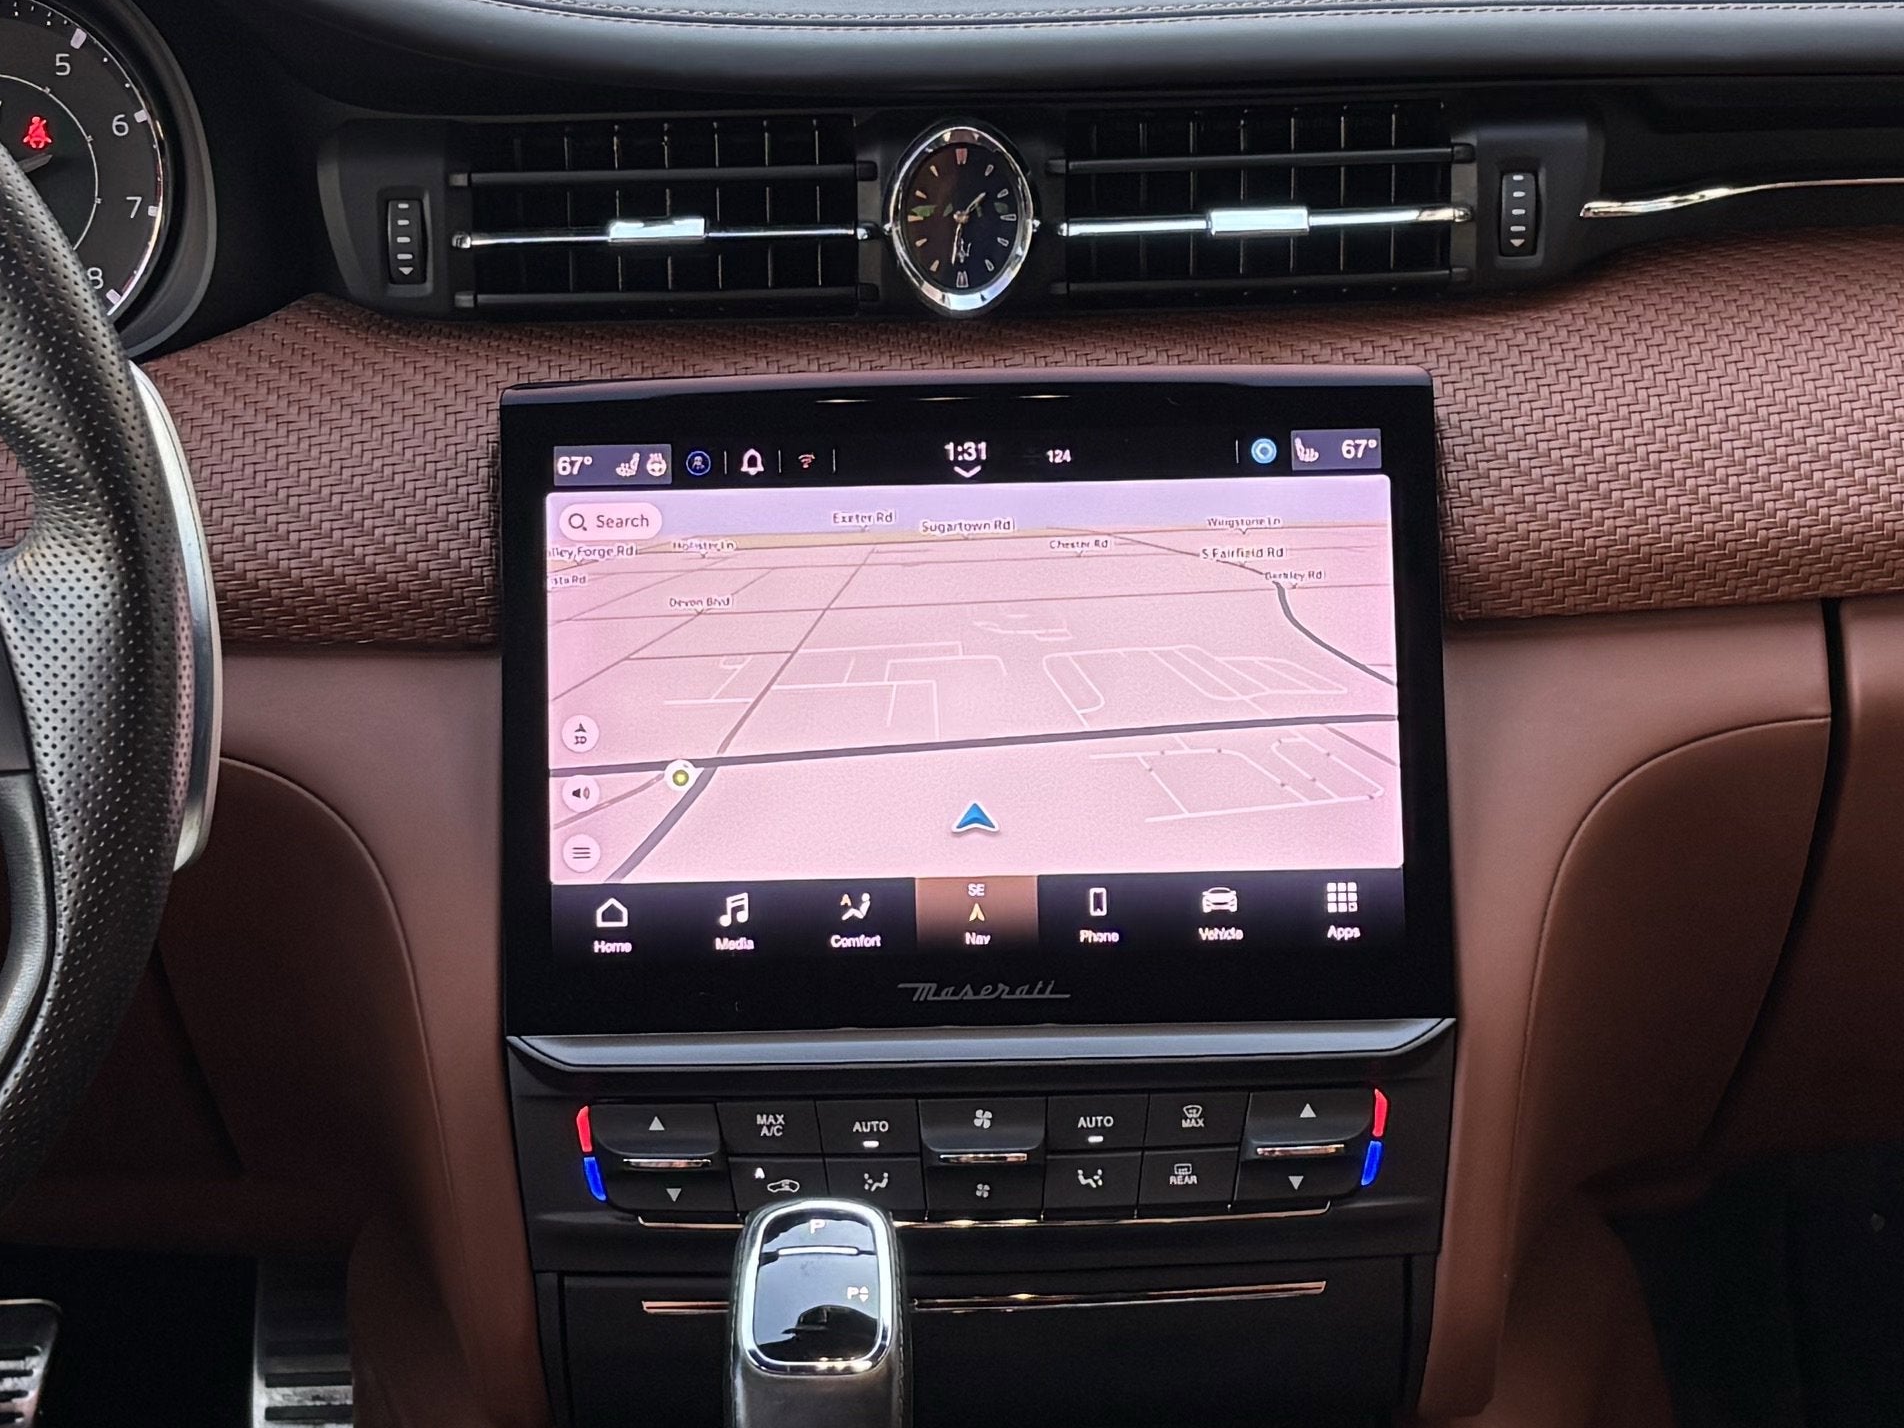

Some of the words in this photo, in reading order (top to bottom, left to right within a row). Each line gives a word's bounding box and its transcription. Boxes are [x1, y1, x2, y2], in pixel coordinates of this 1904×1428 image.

[55, 54, 72, 76] 5
[111, 114, 129, 136] 6
[126, 196, 143, 219] 7
[87, 268, 105, 290] 8
[944, 441, 987, 461] 1:31
[1046, 449, 1072, 464] 124
[1341, 439, 1377, 459] 67°
[556, 456, 593, 476] 67°
[596, 514, 649, 529] Search
[876, 511, 894, 523] Rd
[921, 521, 991, 534] Sugartown
[994, 519, 1011, 532] Rd
[548, 546, 575, 562] lley
[577, 546, 614, 559] Forge
[616, 545, 634, 557] Rd
[1212, 547, 1264, 559] Fairfield
[1266, 547, 1284, 558] Rd
[968, 883, 986, 897] SE
[964, 931, 992, 946] Nav
[1079, 929, 1120, 944] Phone
[1199, 927, 1244, 941] Vehicle
[1327, 925, 1361, 940] Apps
[594, 940, 633, 954] Home
[715, 937, 754, 951] Media
[830, 934, 881, 949] Comfort
[897, 980, 1071, 1002] Maserati
[756, 1114, 785, 1125] MAX
[852, 1121, 889, 1133] AUTO
[1077, 1116, 1114, 1128] AUTO
[1181, 1119, 1205, 1128] MAX
[760, 1125, 783, 1137] A/C
[1169, 1175, 1197, 1185] REAR
[809, 1219, 826, 1234] P
